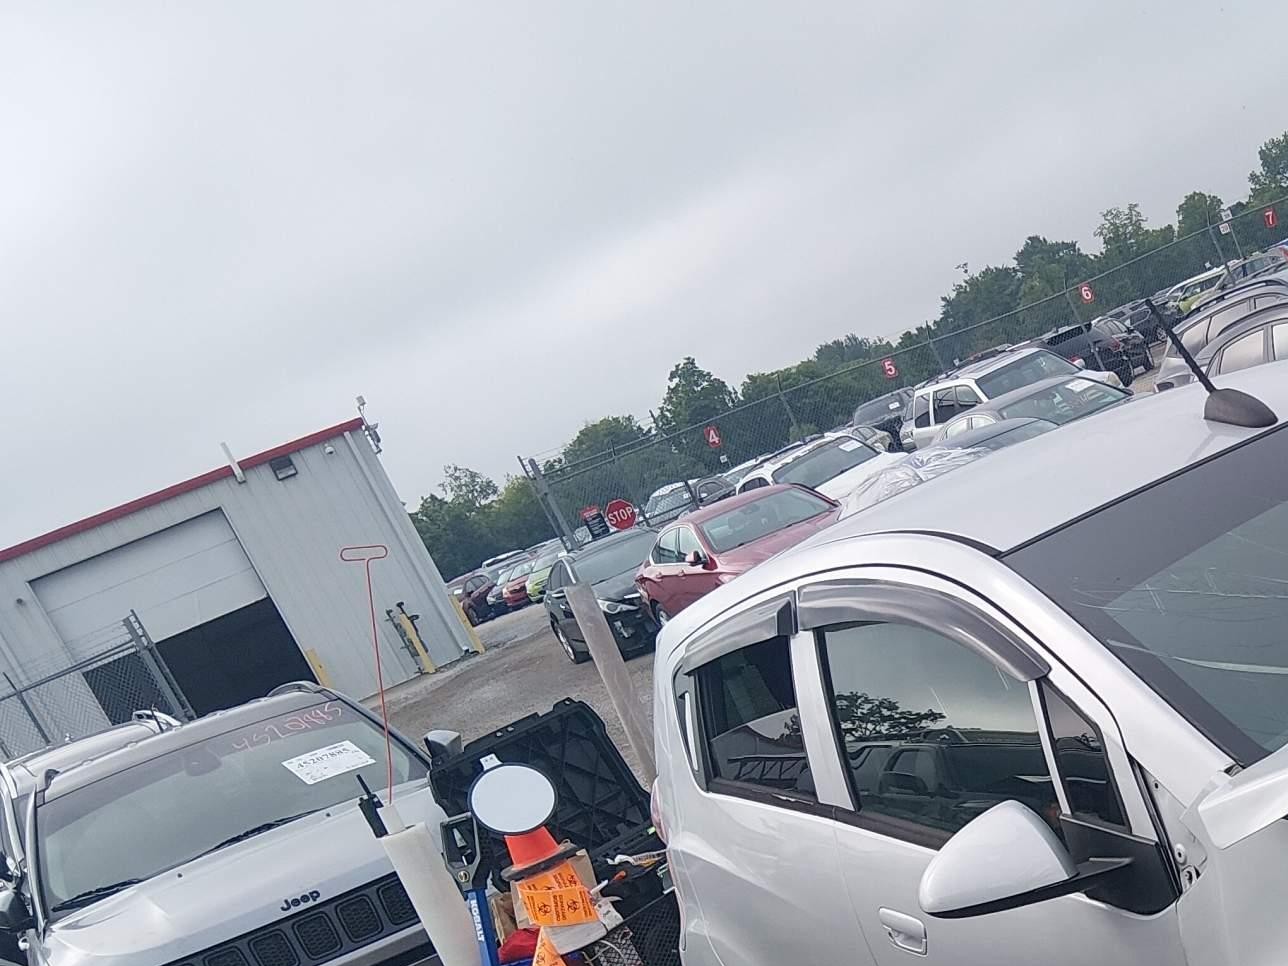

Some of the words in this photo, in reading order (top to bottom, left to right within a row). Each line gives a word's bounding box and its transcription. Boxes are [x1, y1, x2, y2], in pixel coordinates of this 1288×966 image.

[1265, 211, 1273, 224] 7
[1081, 286, 1091, 299] 6
[884, 361, 895, 375] 5
[708, 430, 719, 444] 4
[607, 506, 633, 525] STOP
[280, 890, 320, 911] Jeep
[470, 899, 485, 942] KOBALT
